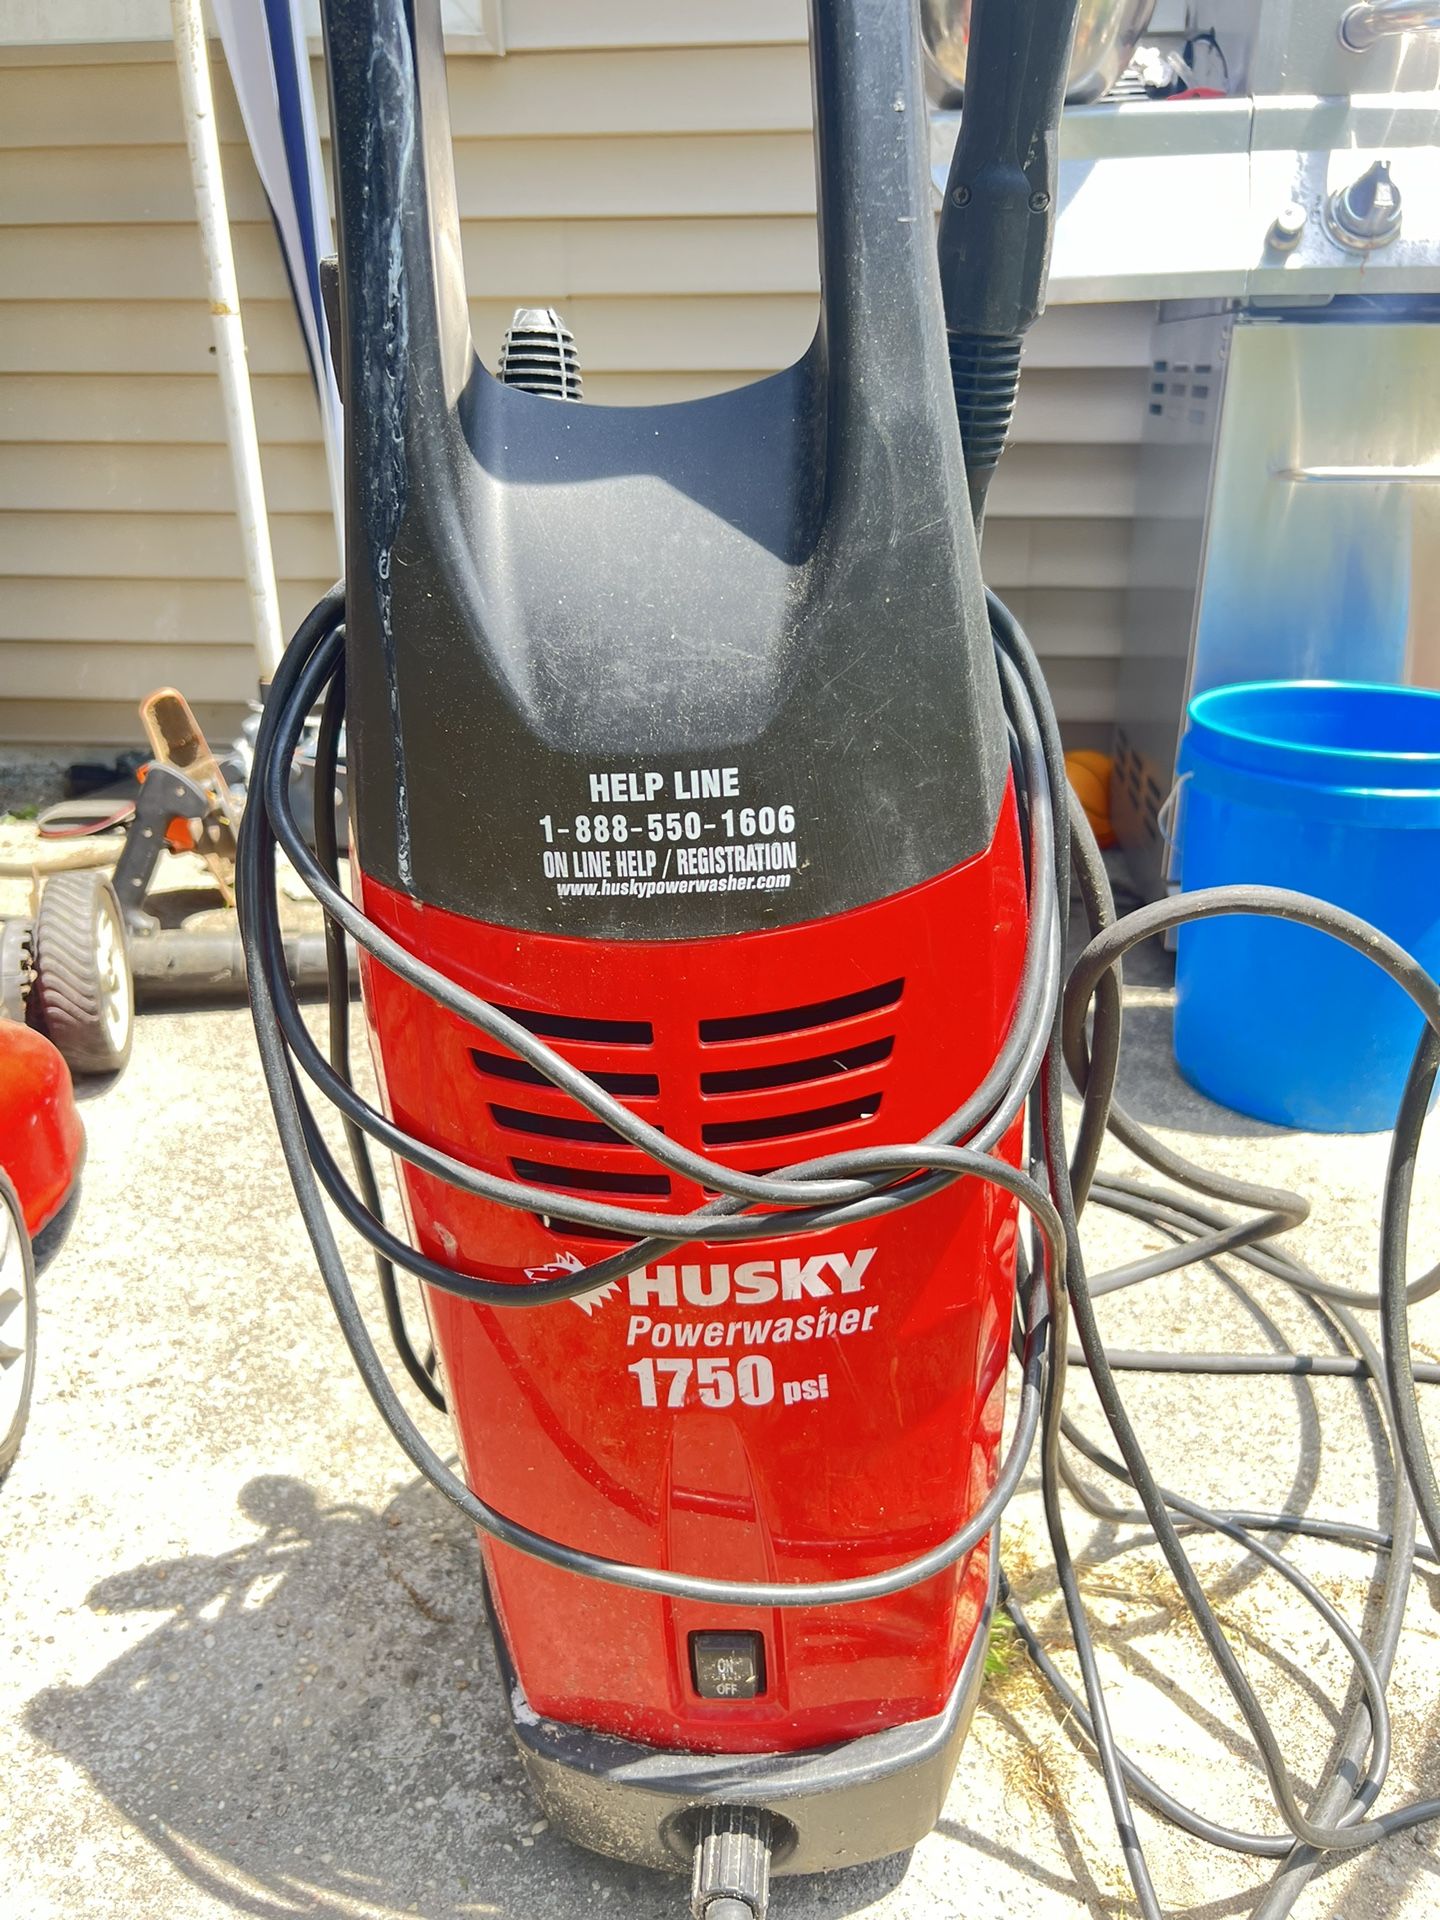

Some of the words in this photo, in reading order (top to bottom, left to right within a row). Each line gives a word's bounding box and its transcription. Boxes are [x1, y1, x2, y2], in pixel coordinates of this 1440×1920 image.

[588, 772, 664, 802] HELP
[673, 767, 740, 800] LINE
[539, 805, 796, 843] 1-888-550-1606
[543, 851, 569, 878] ON
[572, 850, 612, 878] LINE
[615, 850, 657, 877] HELP
[676, 841, 797, 876] REGISTRATION
[556, 873, 791, 898] www.huskypowerwasher.com
[627, 1247, 878, 1306] HUSKY
[627, 1305, 879, 1346] Powerwasher
[627, 1354, 776, 1408] 1750
[782, 1374, 830, 1406] psi
[717, 1658, 734, 1673] ON
[716, 1683, 738, 1695] OFF
